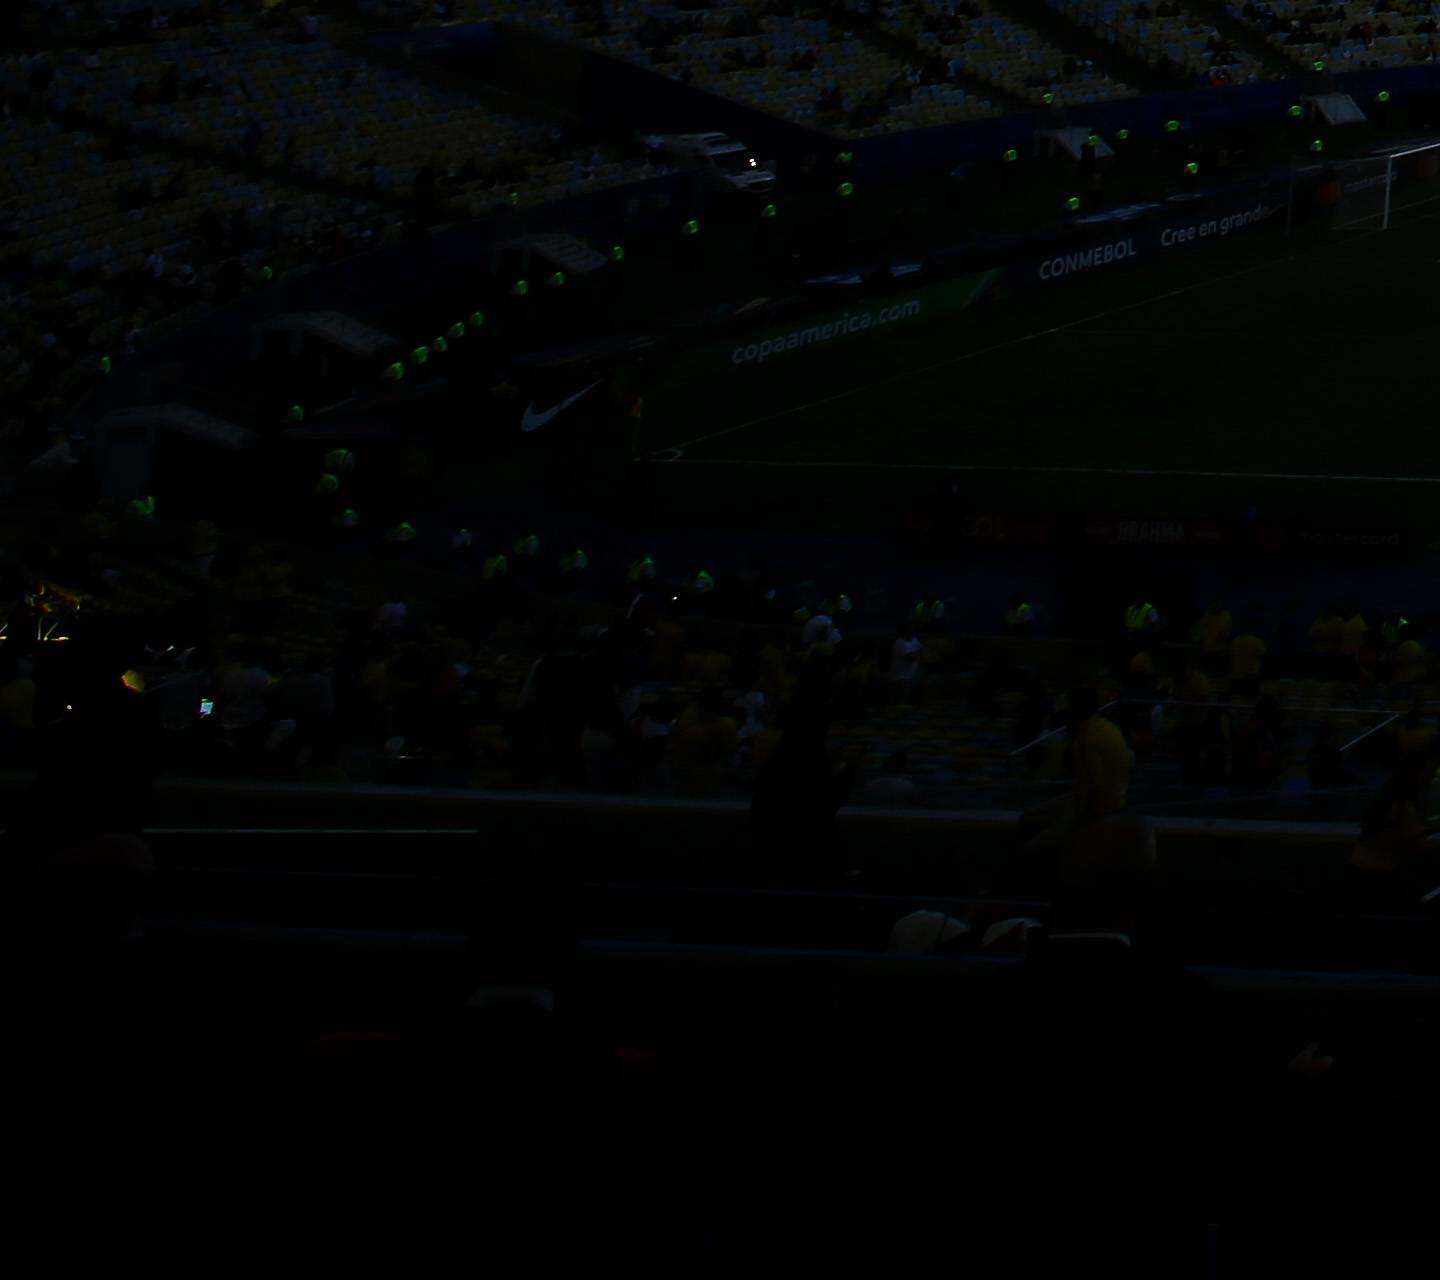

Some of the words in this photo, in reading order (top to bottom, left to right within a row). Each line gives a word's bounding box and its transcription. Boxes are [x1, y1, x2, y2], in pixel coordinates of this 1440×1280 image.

[1160, 226, 1196, 248] Cree
[1200, 221, 1217, 239] en
[1038, 238, 1137, 281] CONMEBOL
[731, 298, 921, 366] copaamerica.com
